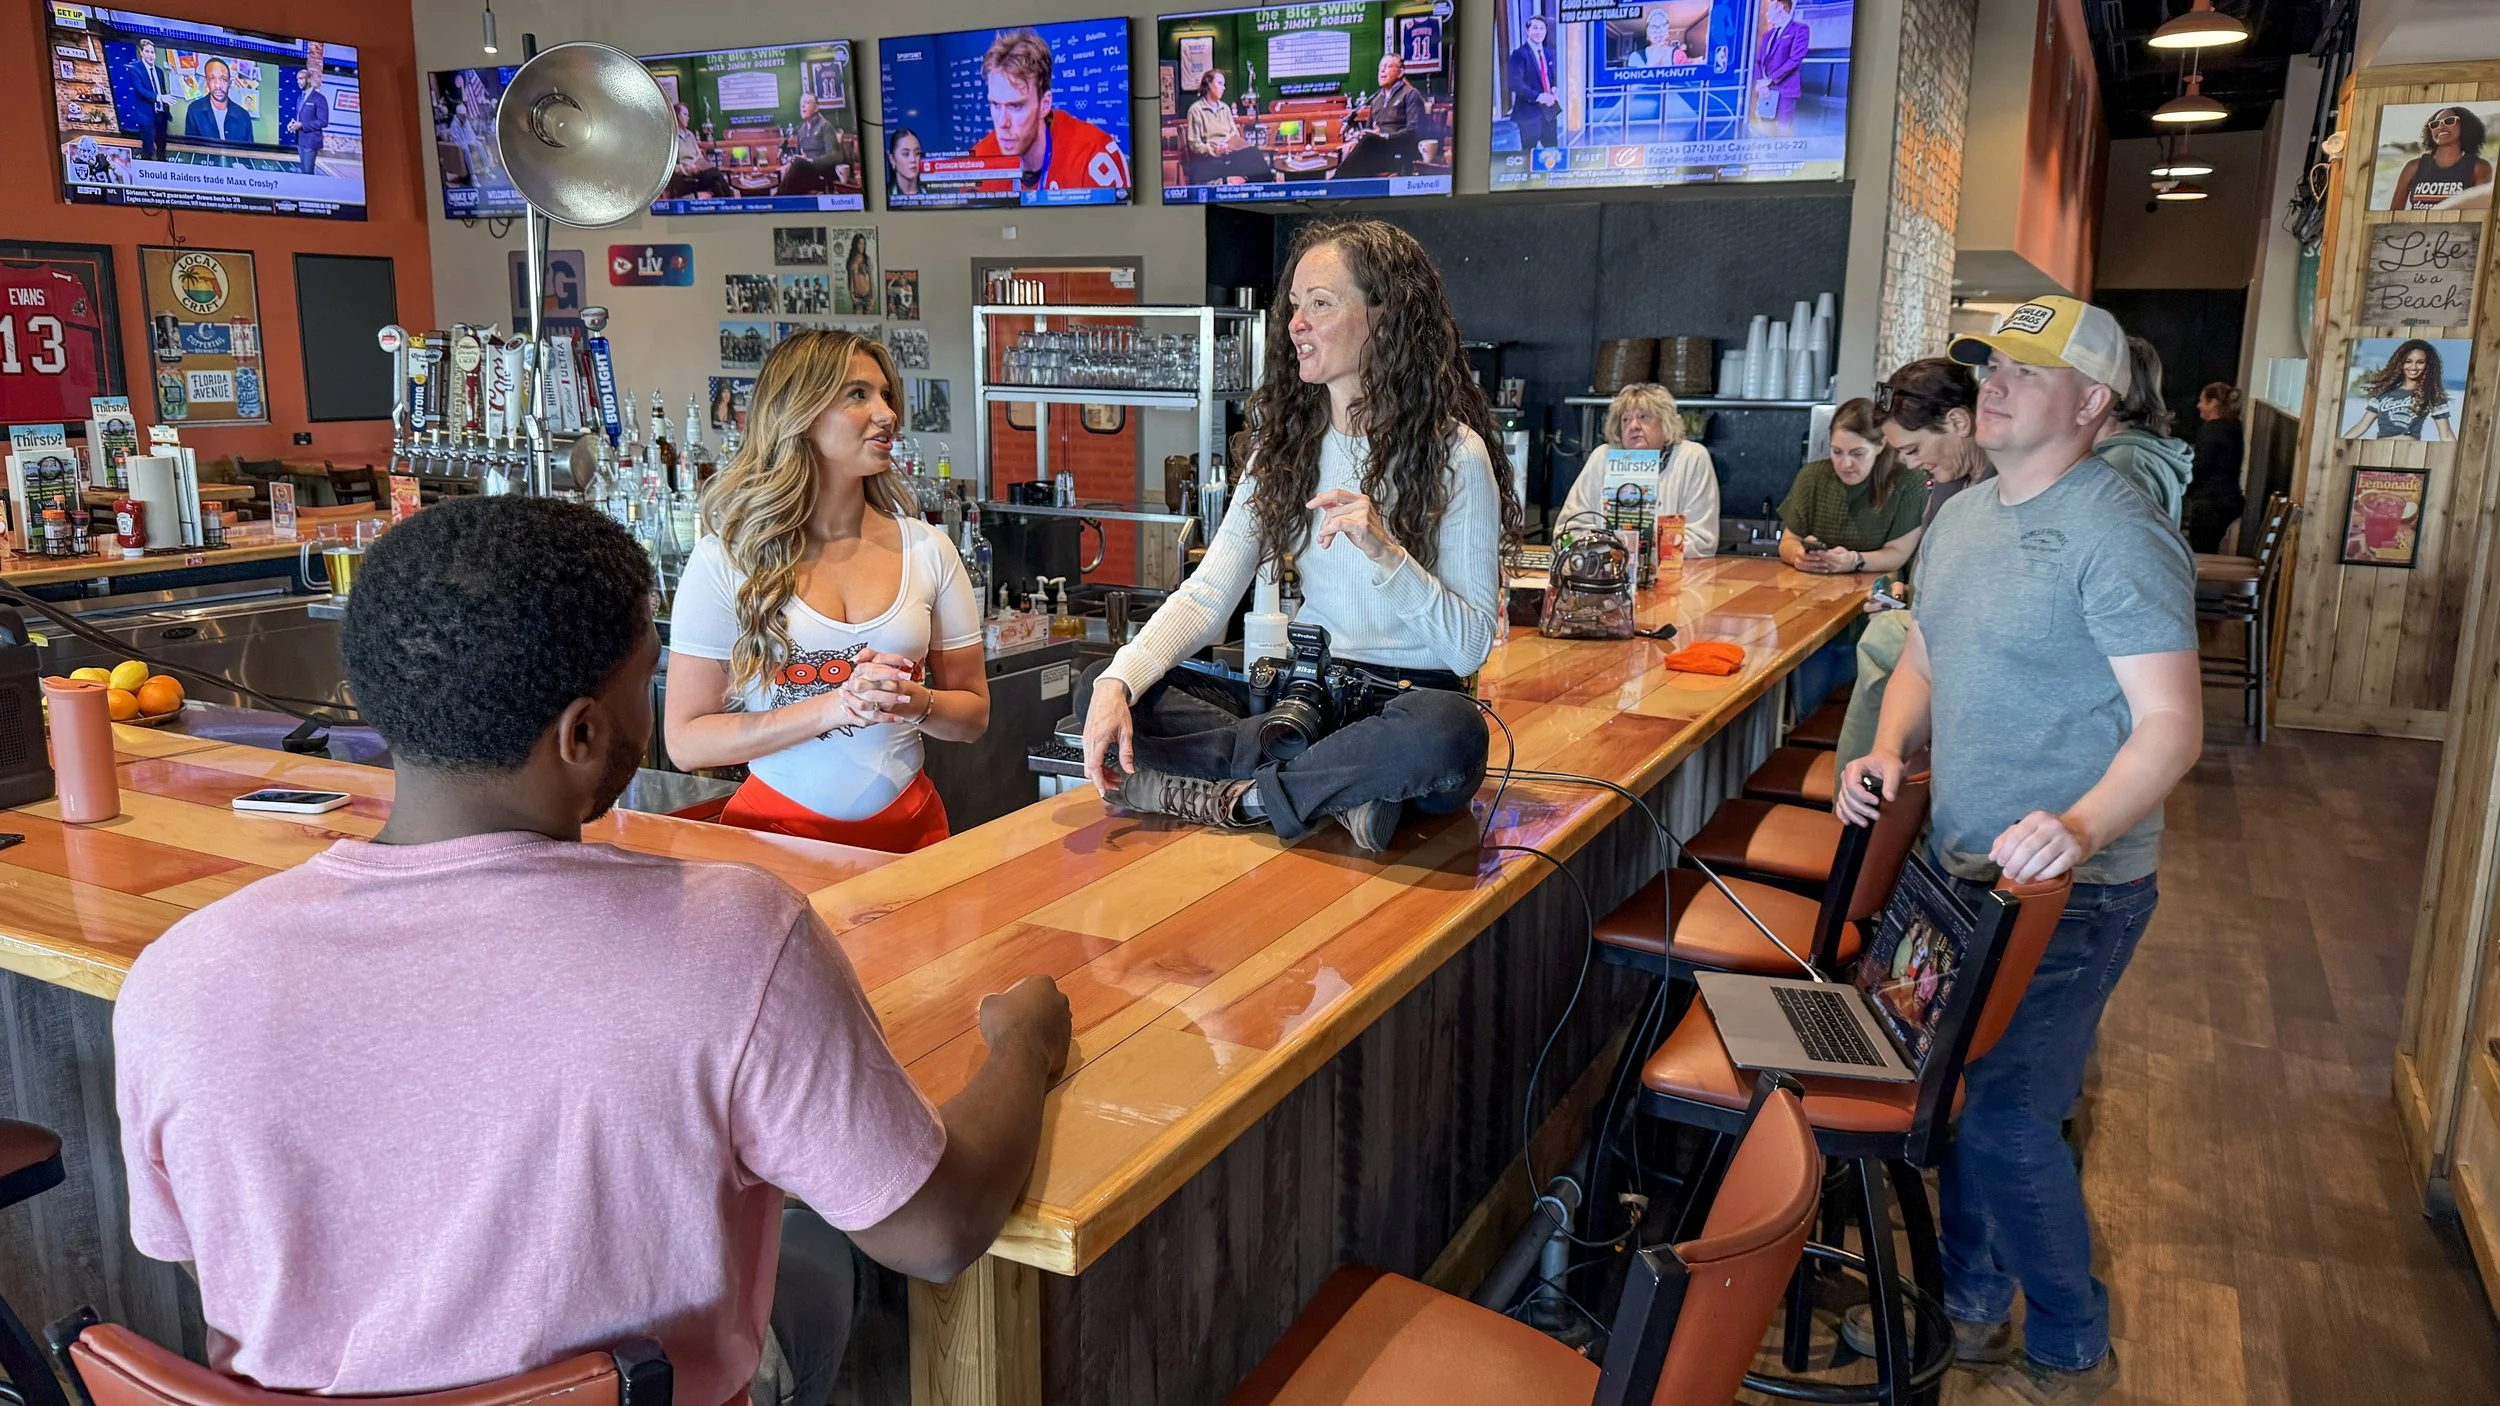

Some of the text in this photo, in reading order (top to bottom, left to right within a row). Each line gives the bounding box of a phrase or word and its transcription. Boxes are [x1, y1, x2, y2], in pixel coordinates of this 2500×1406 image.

[57, 8, 72, 17] GET
[1255, 2, 1366, 23] the BIG SWING
[1257, 14, 1364, 32] with JIMMY ROBERTS
[706, 48, 786, 64] the BIG SWING
[1102, 45, 1121, 57] TCL
[1411, 36, 1431, 61] 11
[708, 58, 785, 72] with JIMMY ROBERTS
[1062, 69, 1076, 78] VISA
[1614, 67, 1697, 80] MONICA McNUTT
[822, 78, 837, 99] 11
[1650, 145, 1680, 155] Knicks
[1682, 143, 1715, 155] (37-21)
[1715, 144, 1727, 152] at
[1727, 141, 1772, 152] Cavaliers
[138, 169, 279, 191] Should Raiders trade Maxx Crosby?
[1406, 179, 1440, 190] Bushnell
[2414, 182, 2464, 195] HOOTERS
[2379, 230, 2468, 272] Life
[178, 254, 219, 273] LOCAL
[637, 256, 664, 273] LIV
[2413, 273, 2443, 284] is a
[8, 287, 46, 306] EVANS
[2369, 284, 2463, 310] Beach
[182, 297, 219, 313] CRAFT
[0, 314, 67, 375] 13
[558, 342, 569, 378] ULTRA
[190, 374, 229, 388] FLORIDA
[594, 352, 618, 425] BUD LIGHT
[192, 384, 231, 399] AVENUE
[94, 402, 128, 413] Thirsty?
[411, 386, 426, 428] Corona
[453, 395, 463, 415] CITY
[13, 432, 63, 448] Thirsty?
[453, 423, 463, 444] CIGAR
[1608, 458, 1657, 472] Thirsty?
[2358, 477, 2421, 491] Lemonade
[1295, 665, 1317, 675] Nikon
